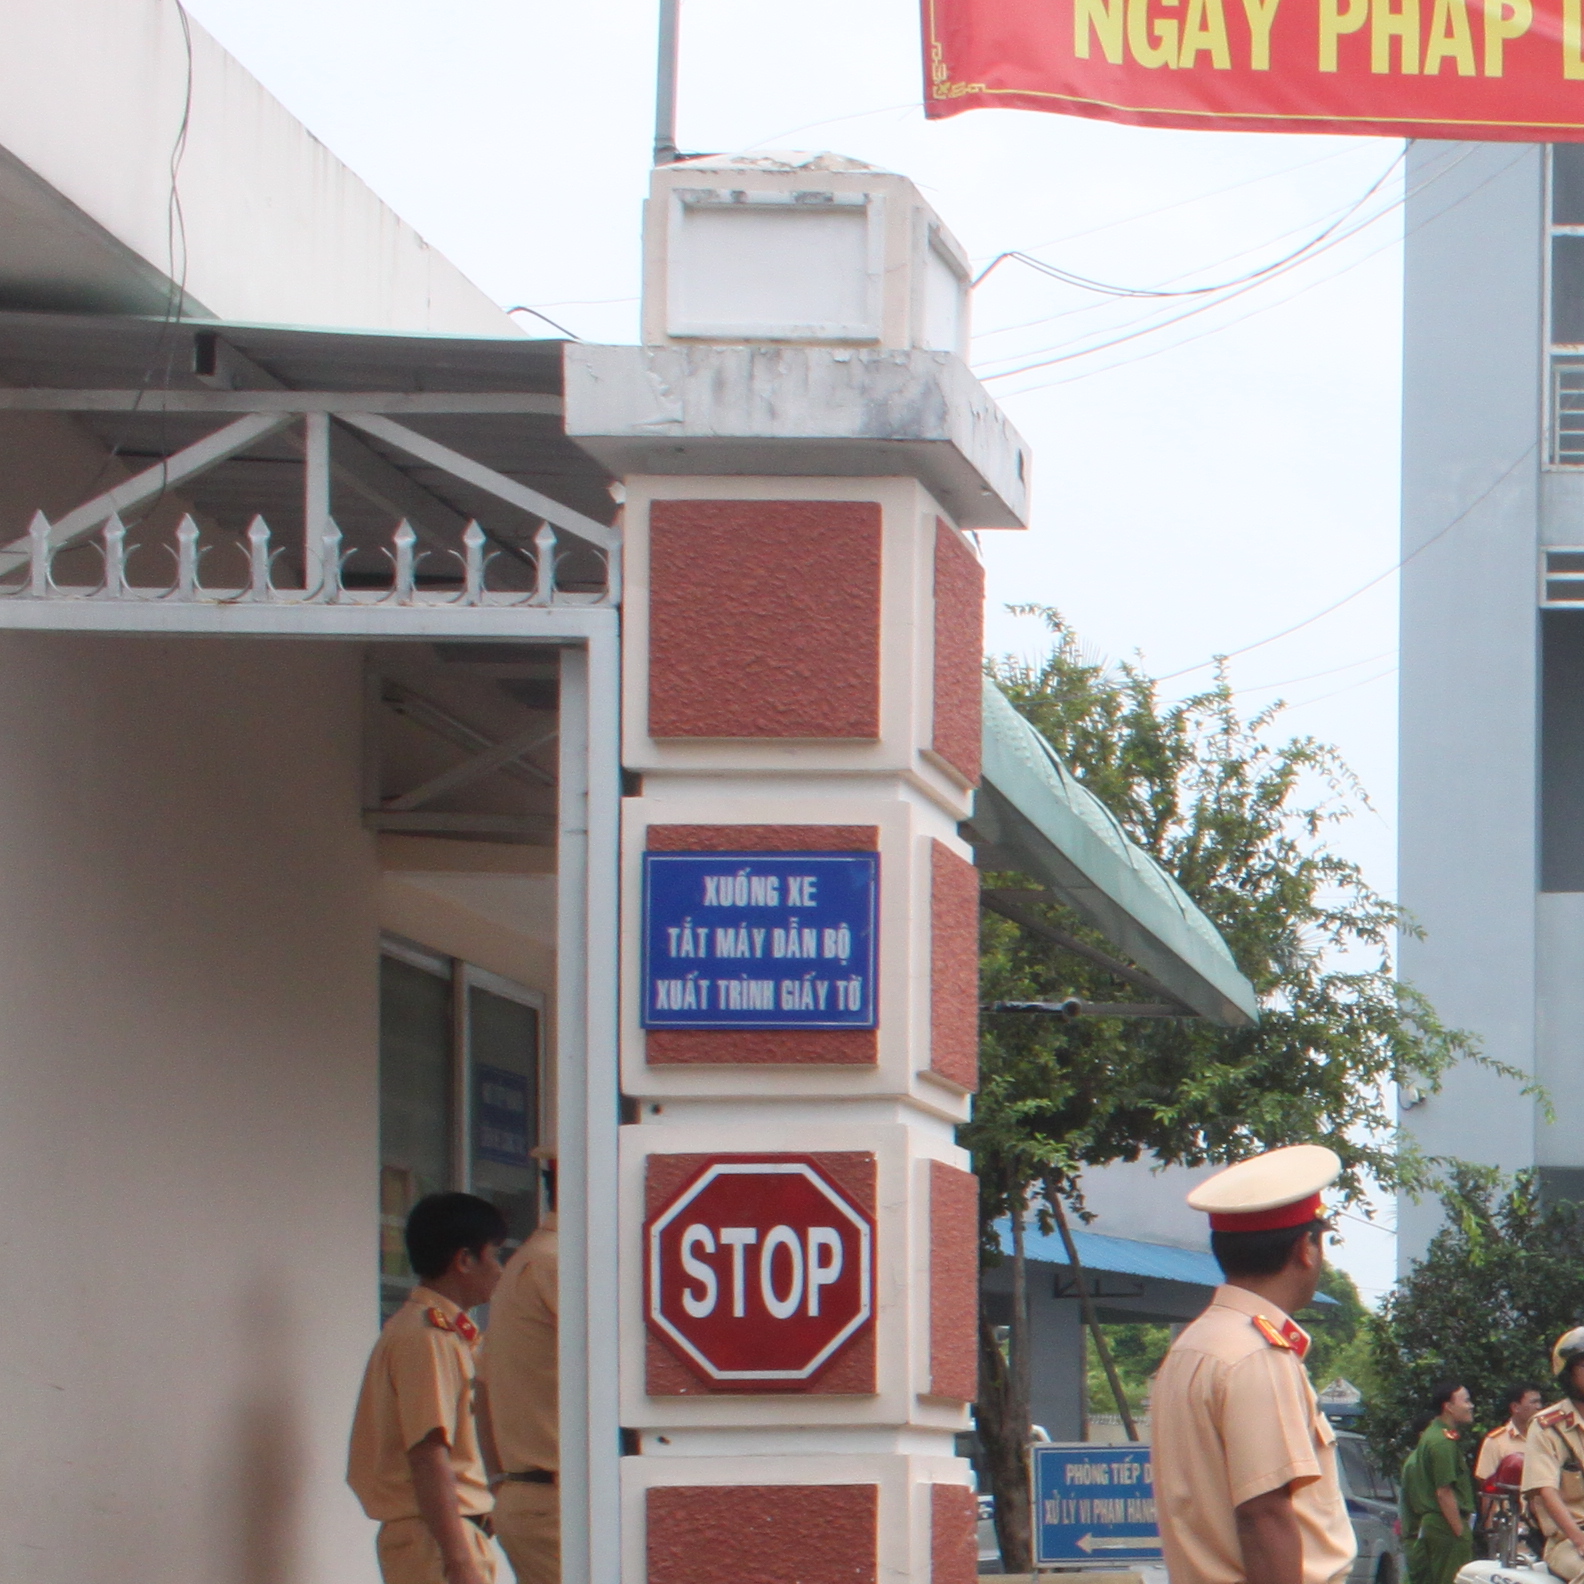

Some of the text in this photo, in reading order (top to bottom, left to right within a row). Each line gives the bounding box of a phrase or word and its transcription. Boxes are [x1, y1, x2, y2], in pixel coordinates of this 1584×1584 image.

[703, 868, 817, 907] XUỐNG XE
[667, 916, 852, 965] TẮT MÁY DẪN BỘ
[655, 971, 862, 1012] XUẤT TRÌNH GIẤY TỜ
[680, 1223, 844, 1319] STOP
[1065, 1458, 1109, 1485] PHÒNG
[1112, 1455, 1141, 1485] TIẾP
[1062, 1492, 1076, 1525] LÝ
[1080, 1499, 1091, 1525] VI
[1093, 1498, 1125, 1529] PHẠM
